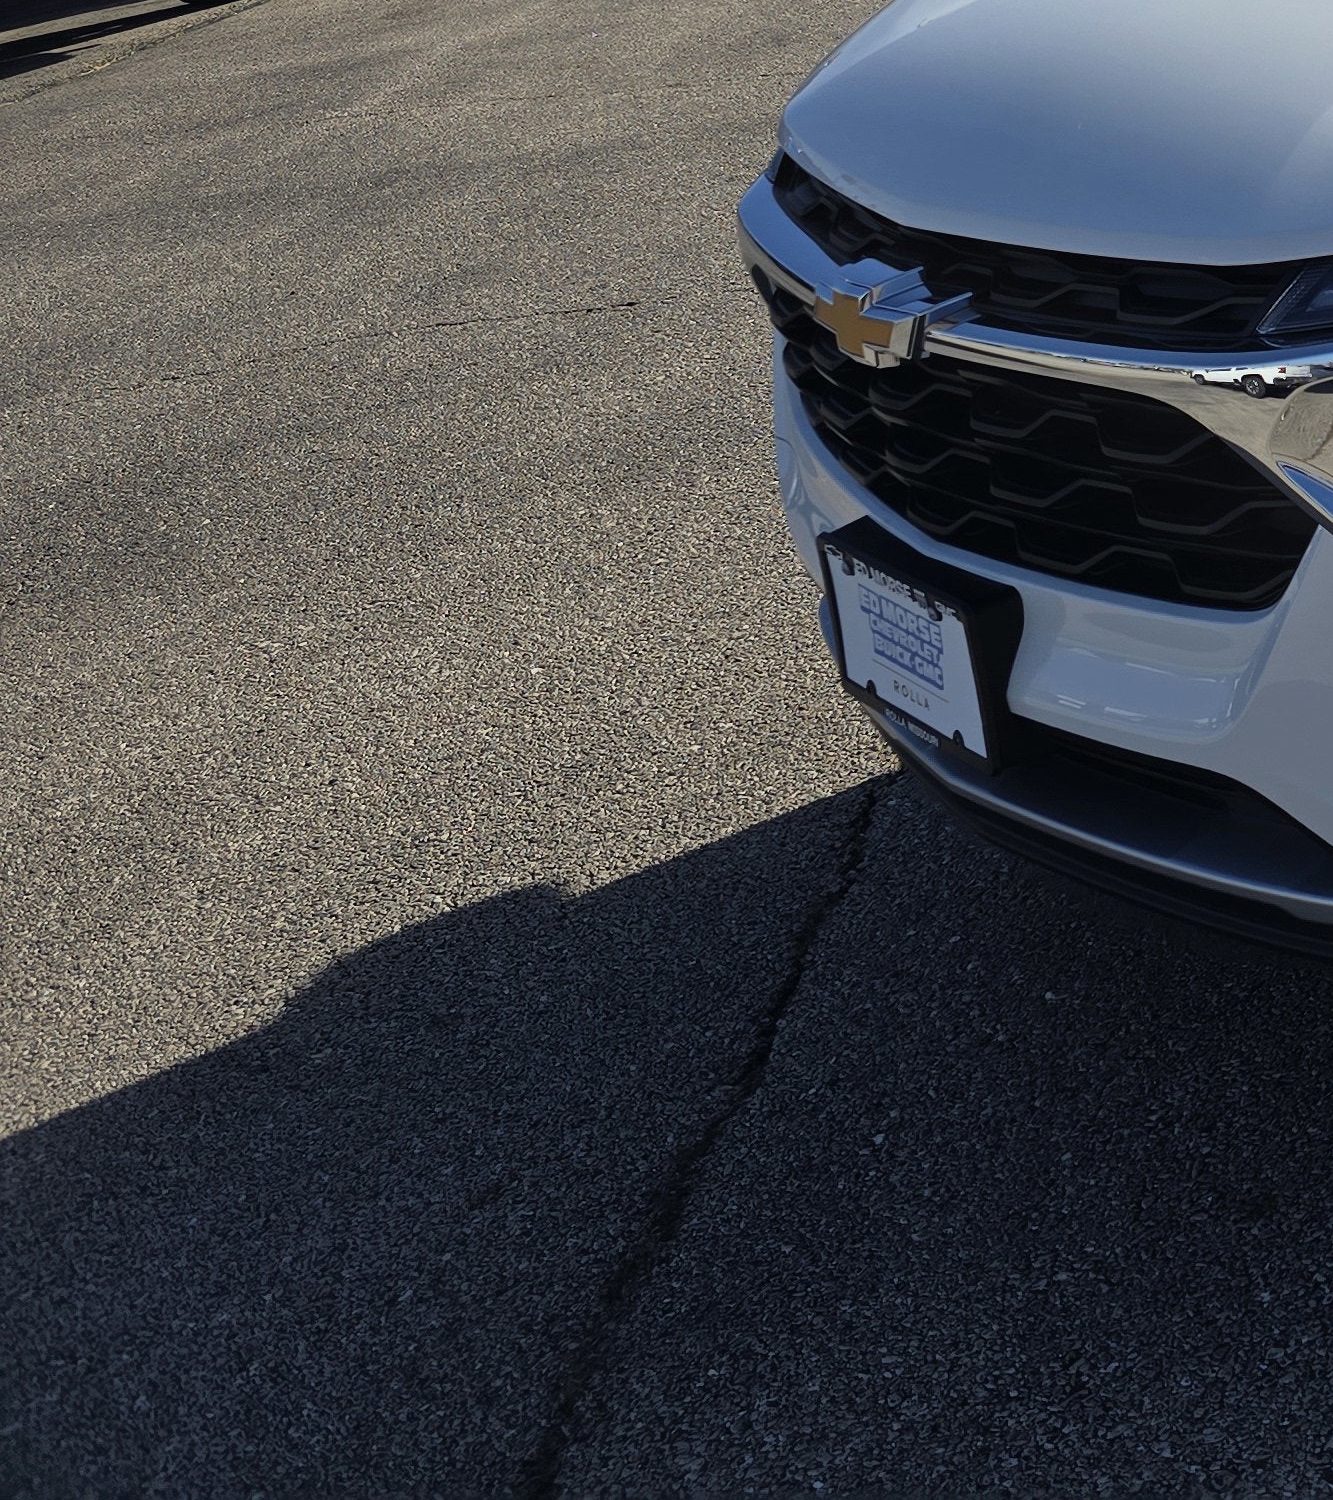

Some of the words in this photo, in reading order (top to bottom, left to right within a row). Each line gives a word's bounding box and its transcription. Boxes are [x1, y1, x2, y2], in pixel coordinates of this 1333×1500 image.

[869, 566, 912, 599] MORSE
[859, 586, 881, 616] ED
[881, 597, 943, 652] MORSE
[893, 679, 930, 711] ROLLA
